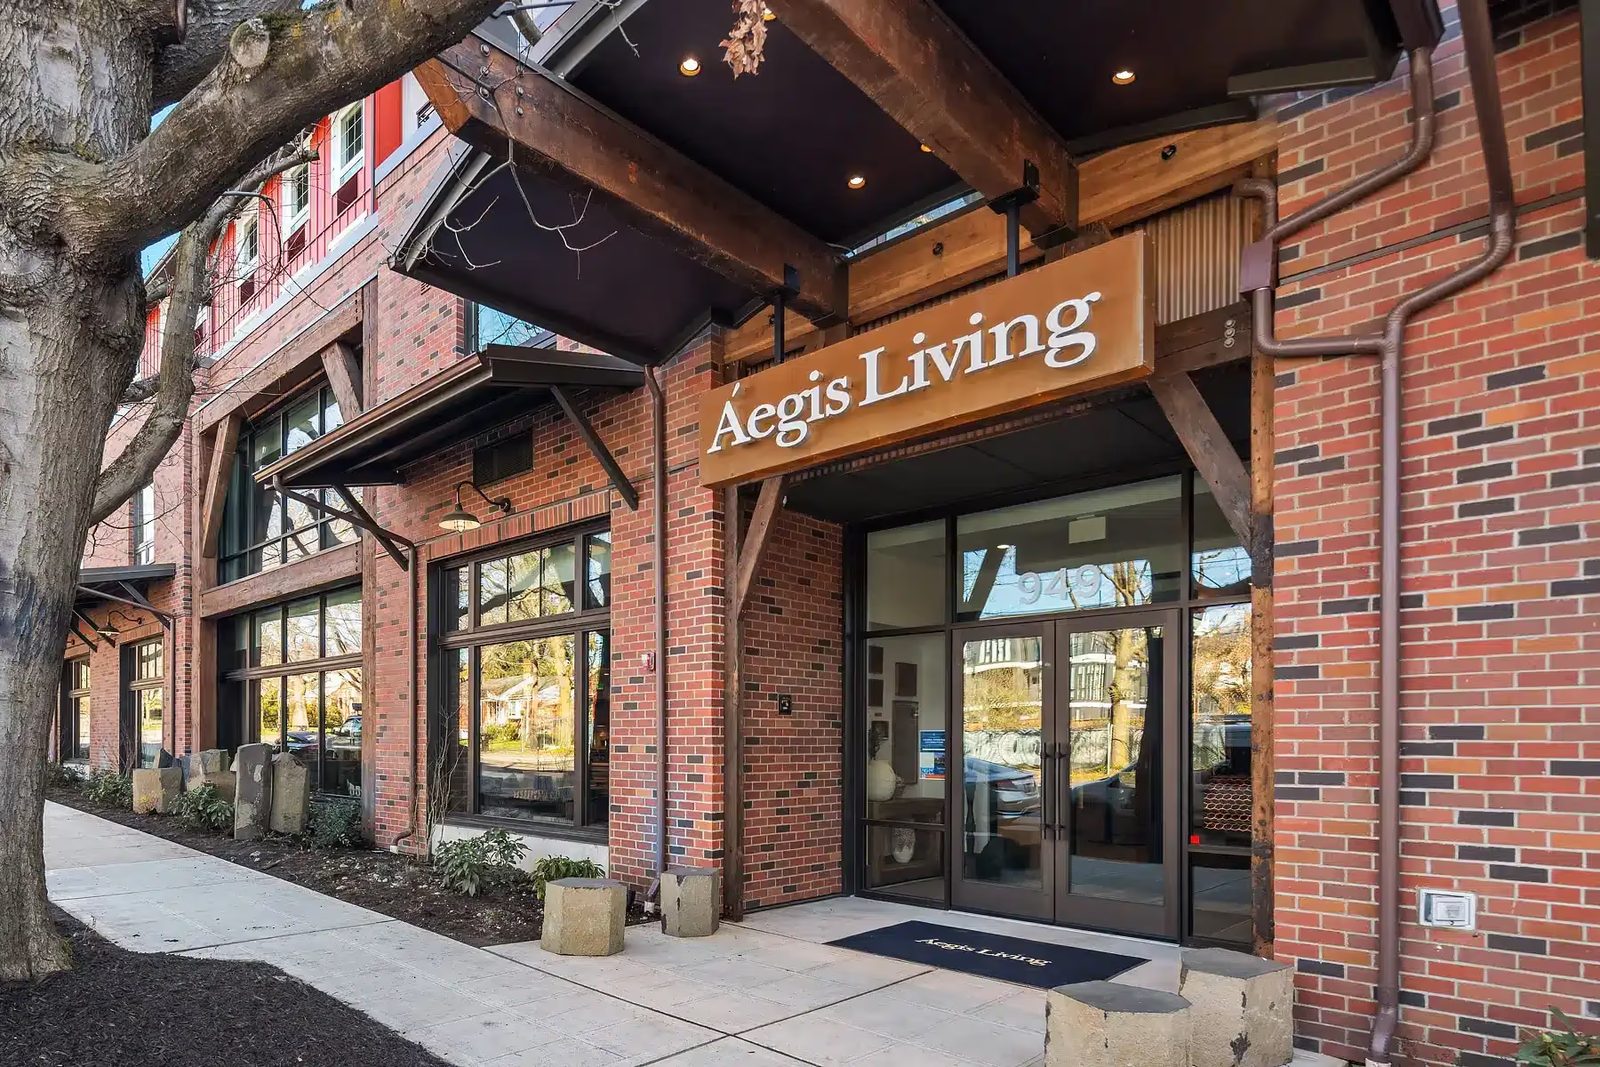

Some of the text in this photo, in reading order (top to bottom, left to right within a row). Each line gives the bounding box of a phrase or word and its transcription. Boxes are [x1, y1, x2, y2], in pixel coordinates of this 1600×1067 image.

[857, 291, 1102, 407] Living
[1019, 564, 1101, 604] 949
[976, 948, 1052, 967] Living
